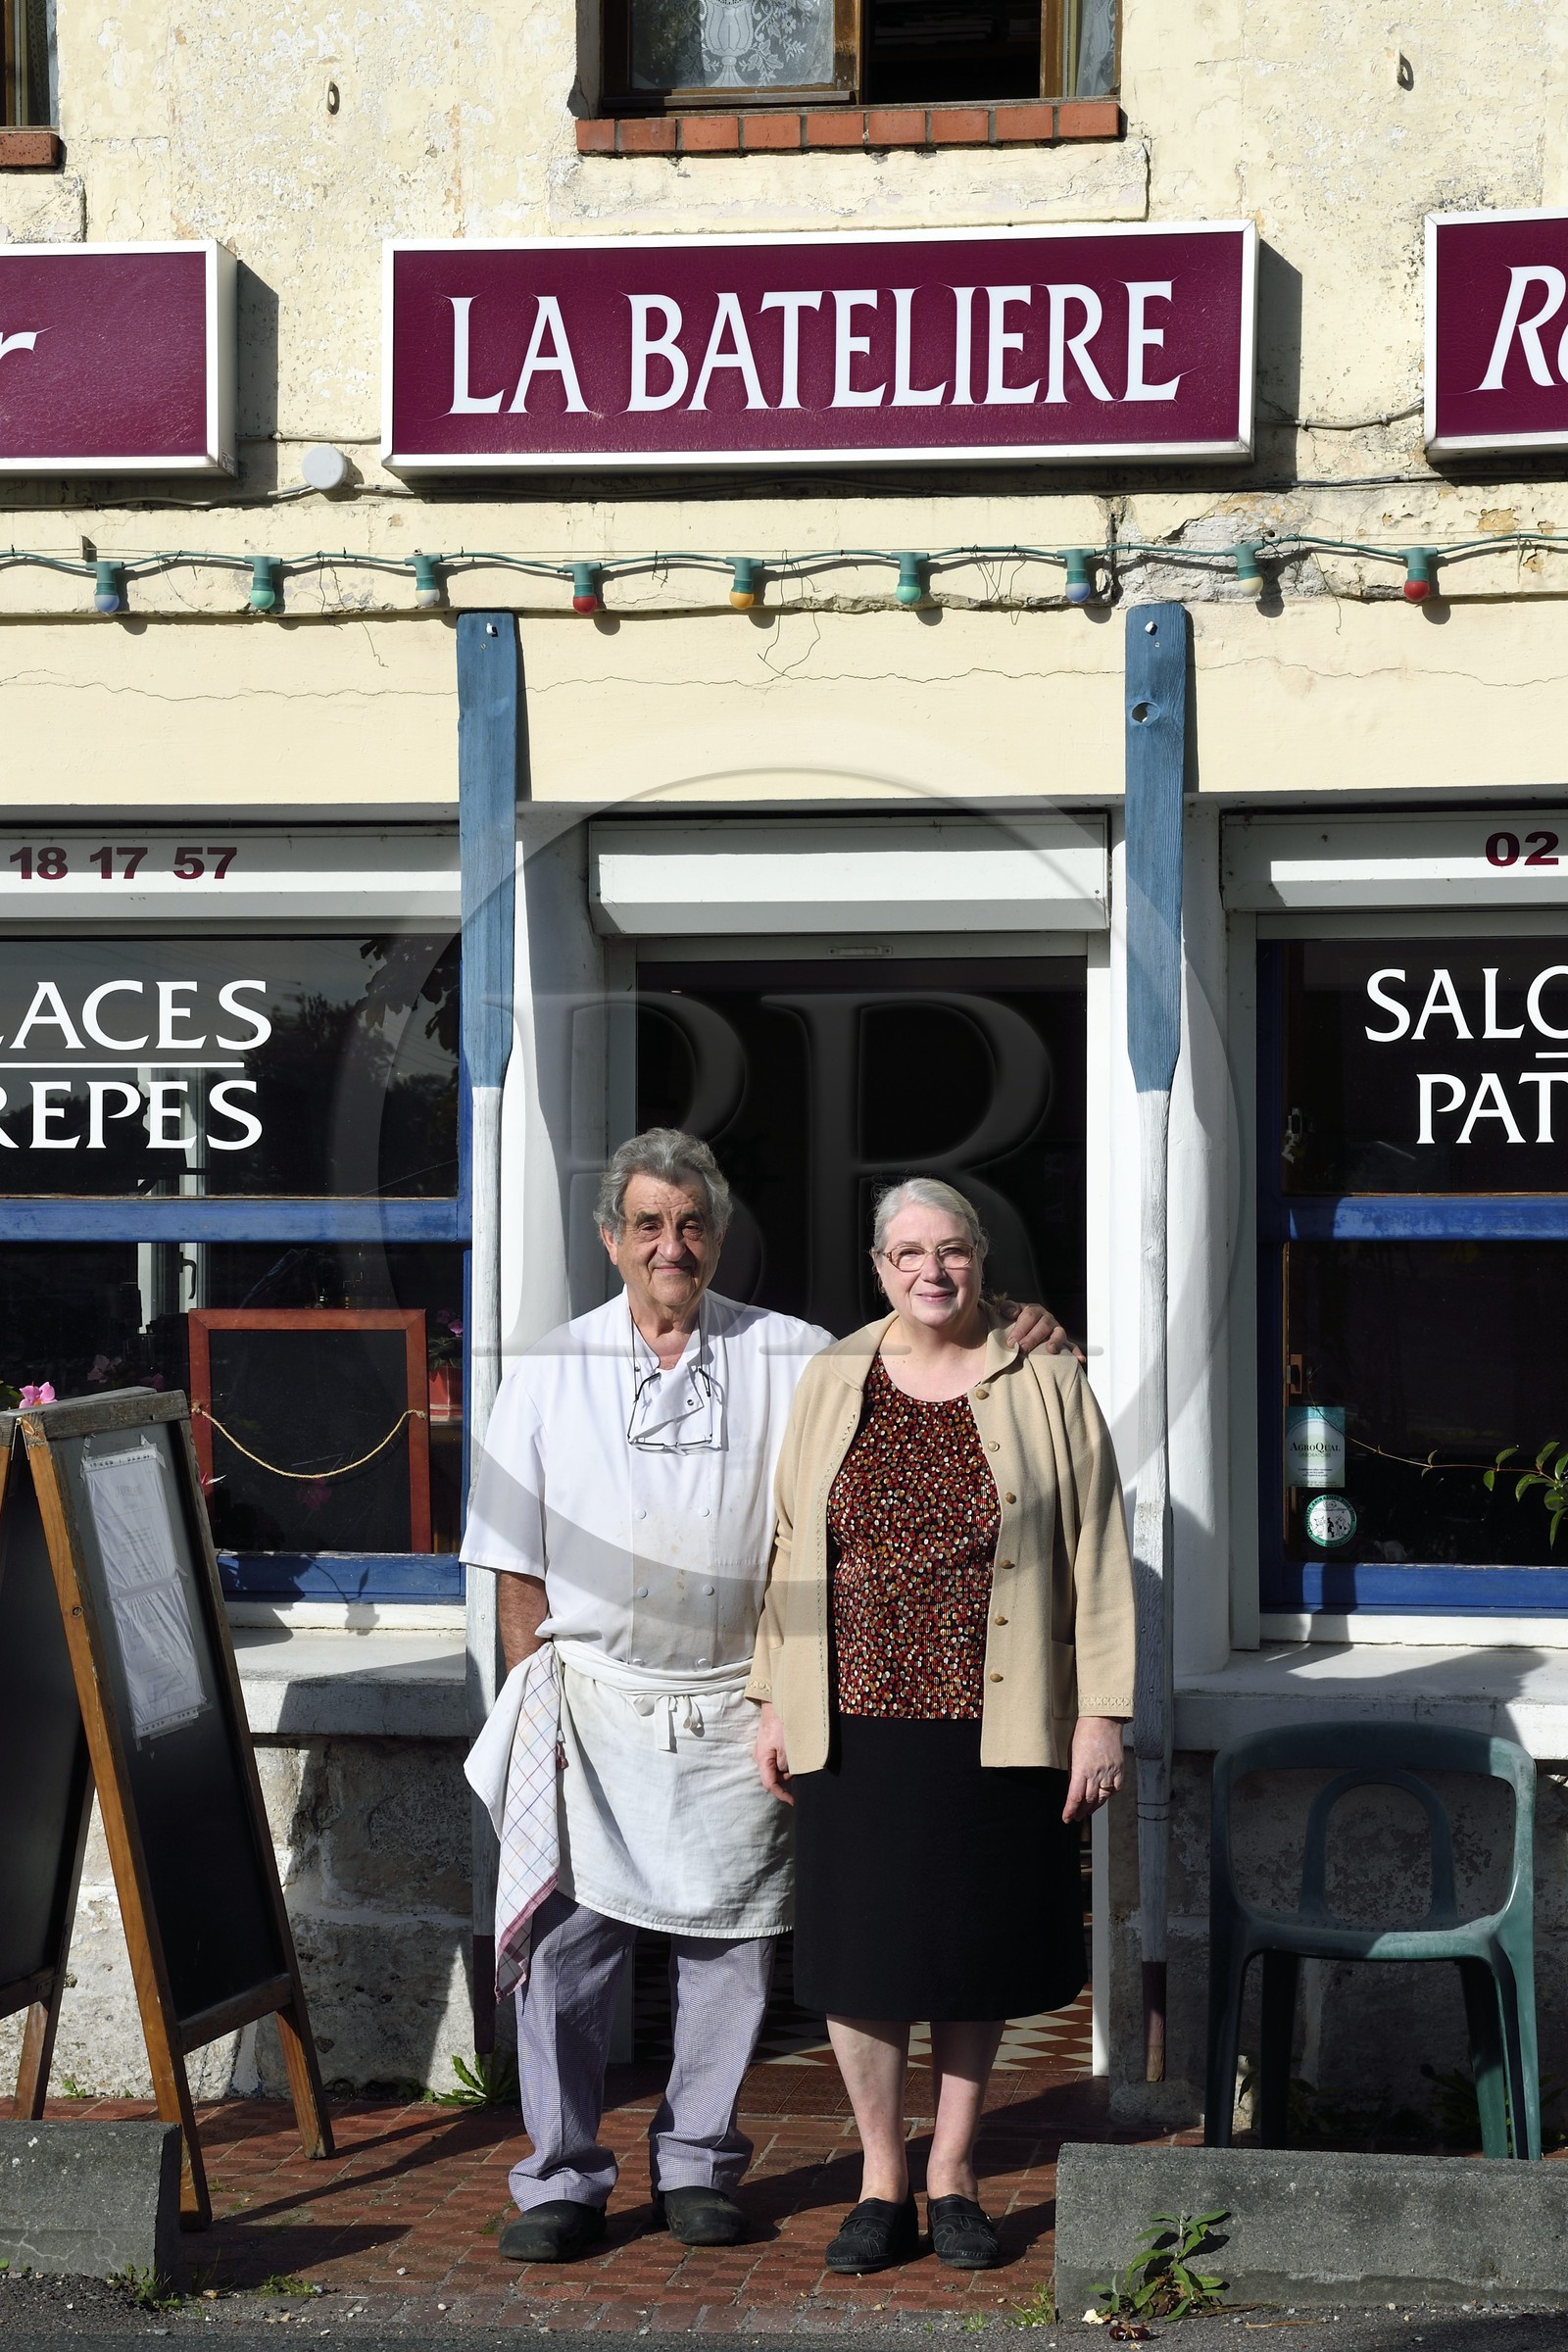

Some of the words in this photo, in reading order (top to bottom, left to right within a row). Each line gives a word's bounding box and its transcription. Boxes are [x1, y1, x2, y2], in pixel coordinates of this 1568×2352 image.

[446, 295, 597, 416] LA
[624, 280, 1188, 413] BATELIERE
[1470, 265, 1568, 391] R
[9, 846, 69, 880] 18
[89, 846, 148, 880] 17
[172, 846, 238, 880] 57
[1485, 831, 1560, 867] 02
[0, 979, 272, 1051] ACES
[1416, 1071, 1568, 1145] PAT
